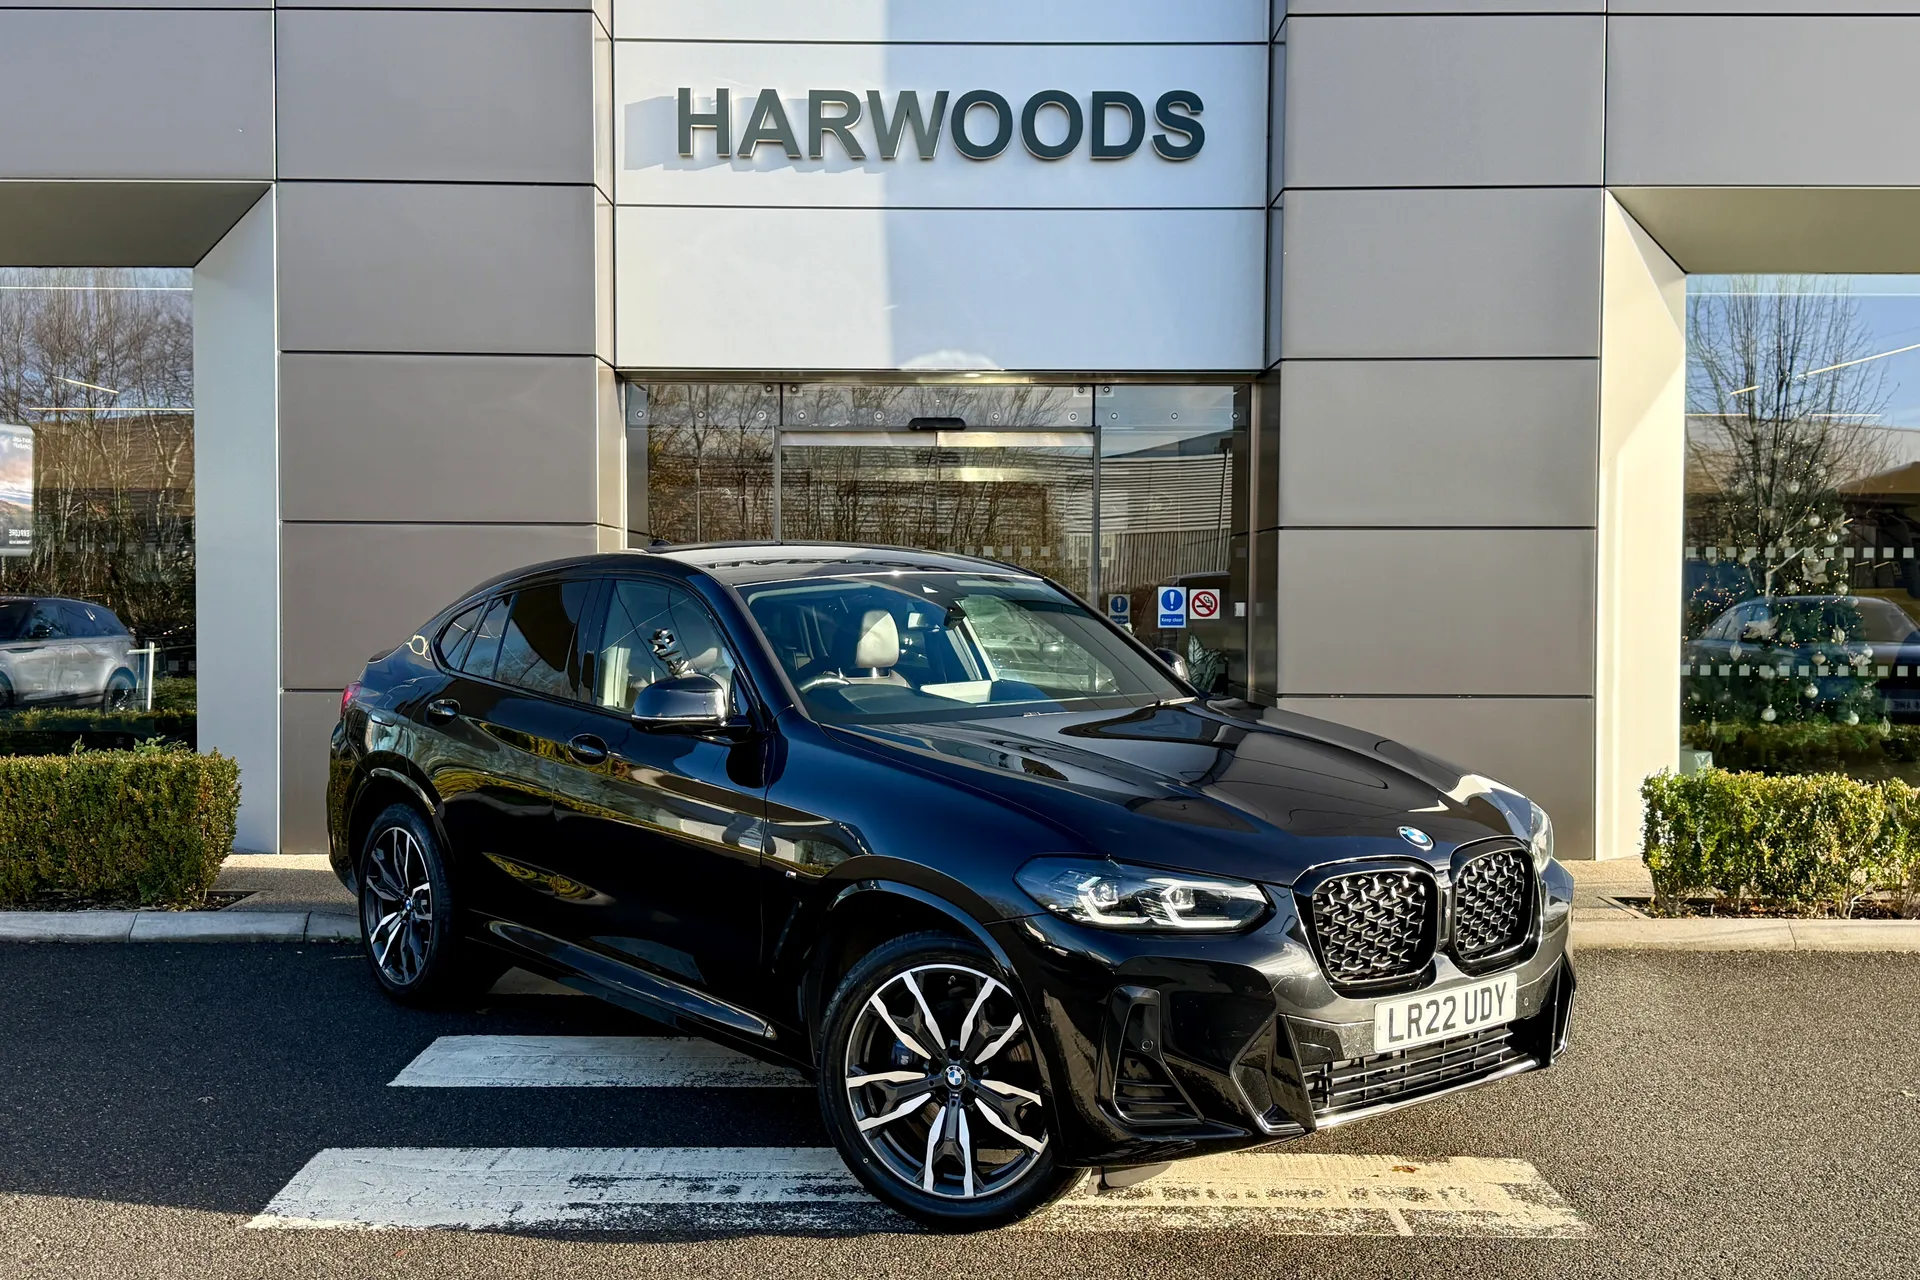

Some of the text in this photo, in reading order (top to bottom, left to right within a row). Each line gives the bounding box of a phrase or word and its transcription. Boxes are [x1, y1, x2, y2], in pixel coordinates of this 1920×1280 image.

[678, 87, 1206, 161] HARWOODS
[1389, 981, 1507, 1043] LR22 UDY
